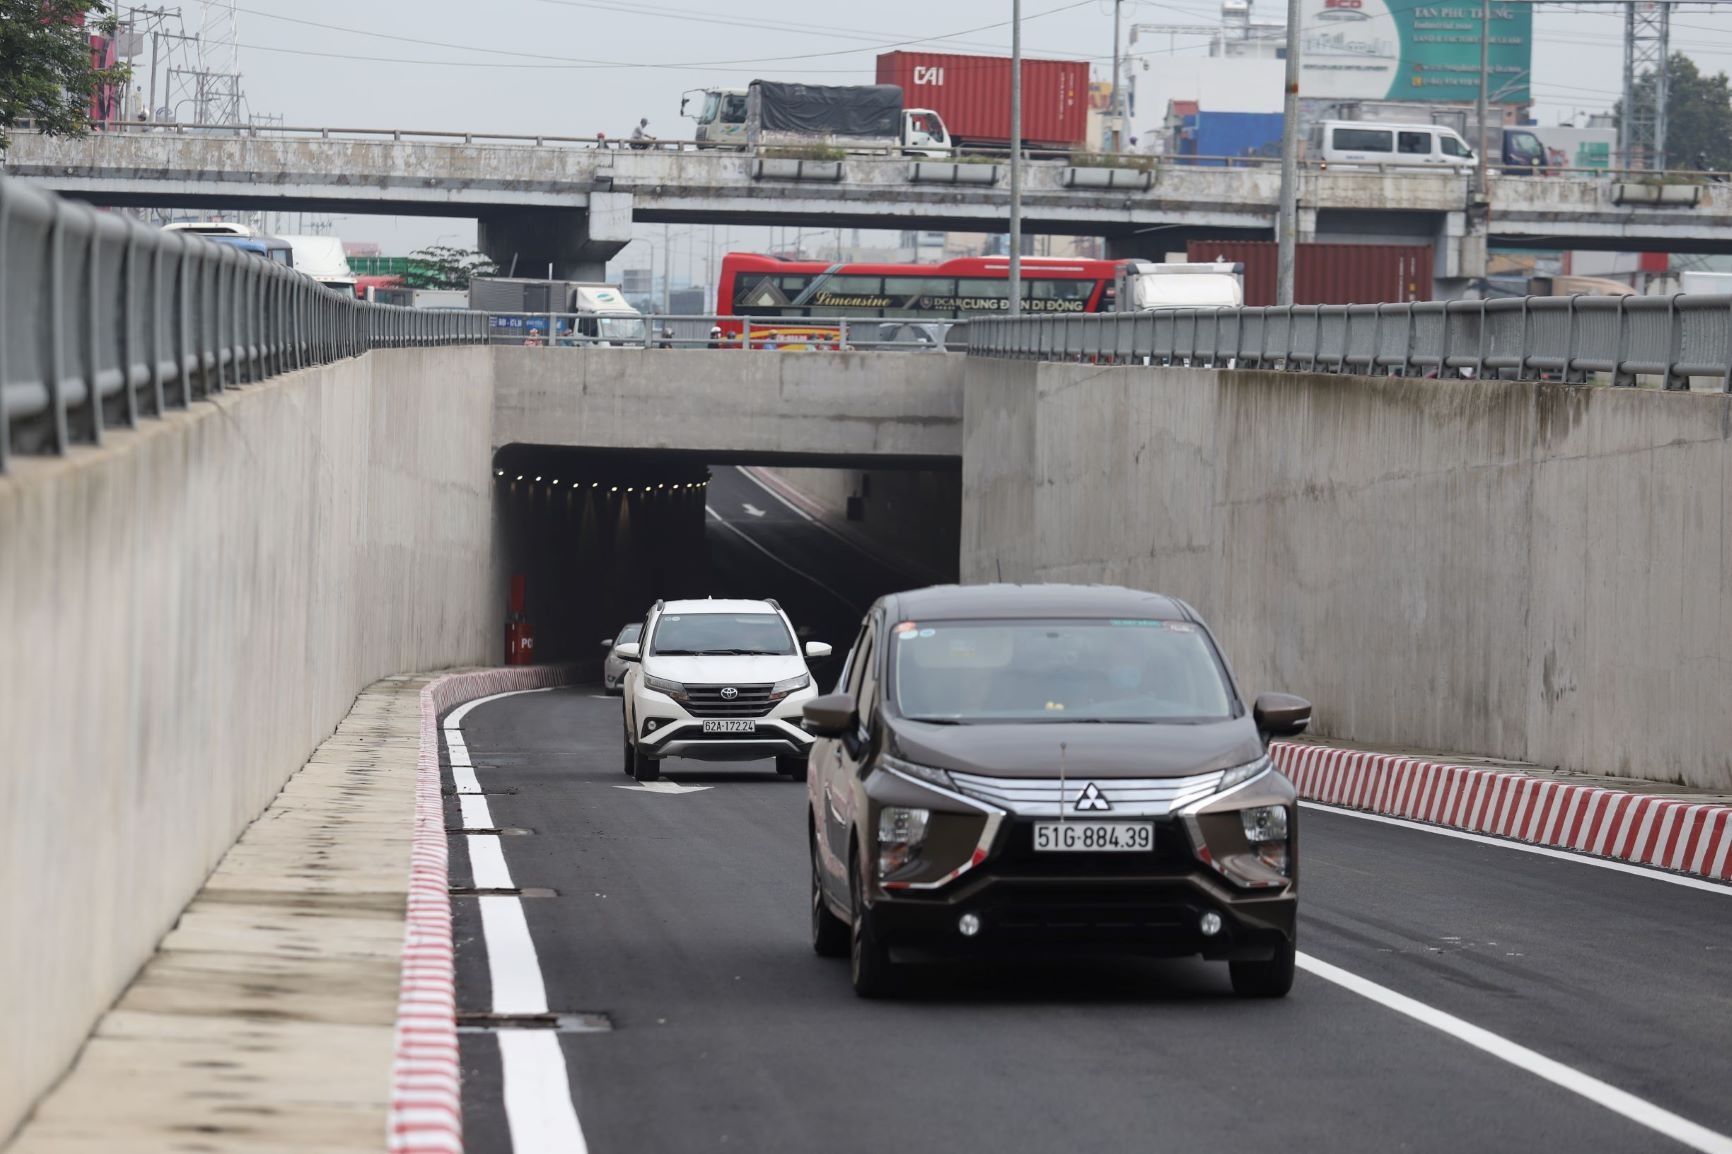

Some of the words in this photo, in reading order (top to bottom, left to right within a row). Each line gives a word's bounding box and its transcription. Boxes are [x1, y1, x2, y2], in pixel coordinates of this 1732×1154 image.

[914, 66, 944, 86] CAI
[815, 290, 892, 307] Limousine
[962, 298, 998, 309] CUNG
[1000, 299, 1030, 310] ĐN
[1032, 300, 1045, 310] DI
[1047, 299, 1083, 312] ĐỘNG
[705, 721, 753, 732] 62A-172.24
[1038, 826, 1149, 848] 51G-884.39
